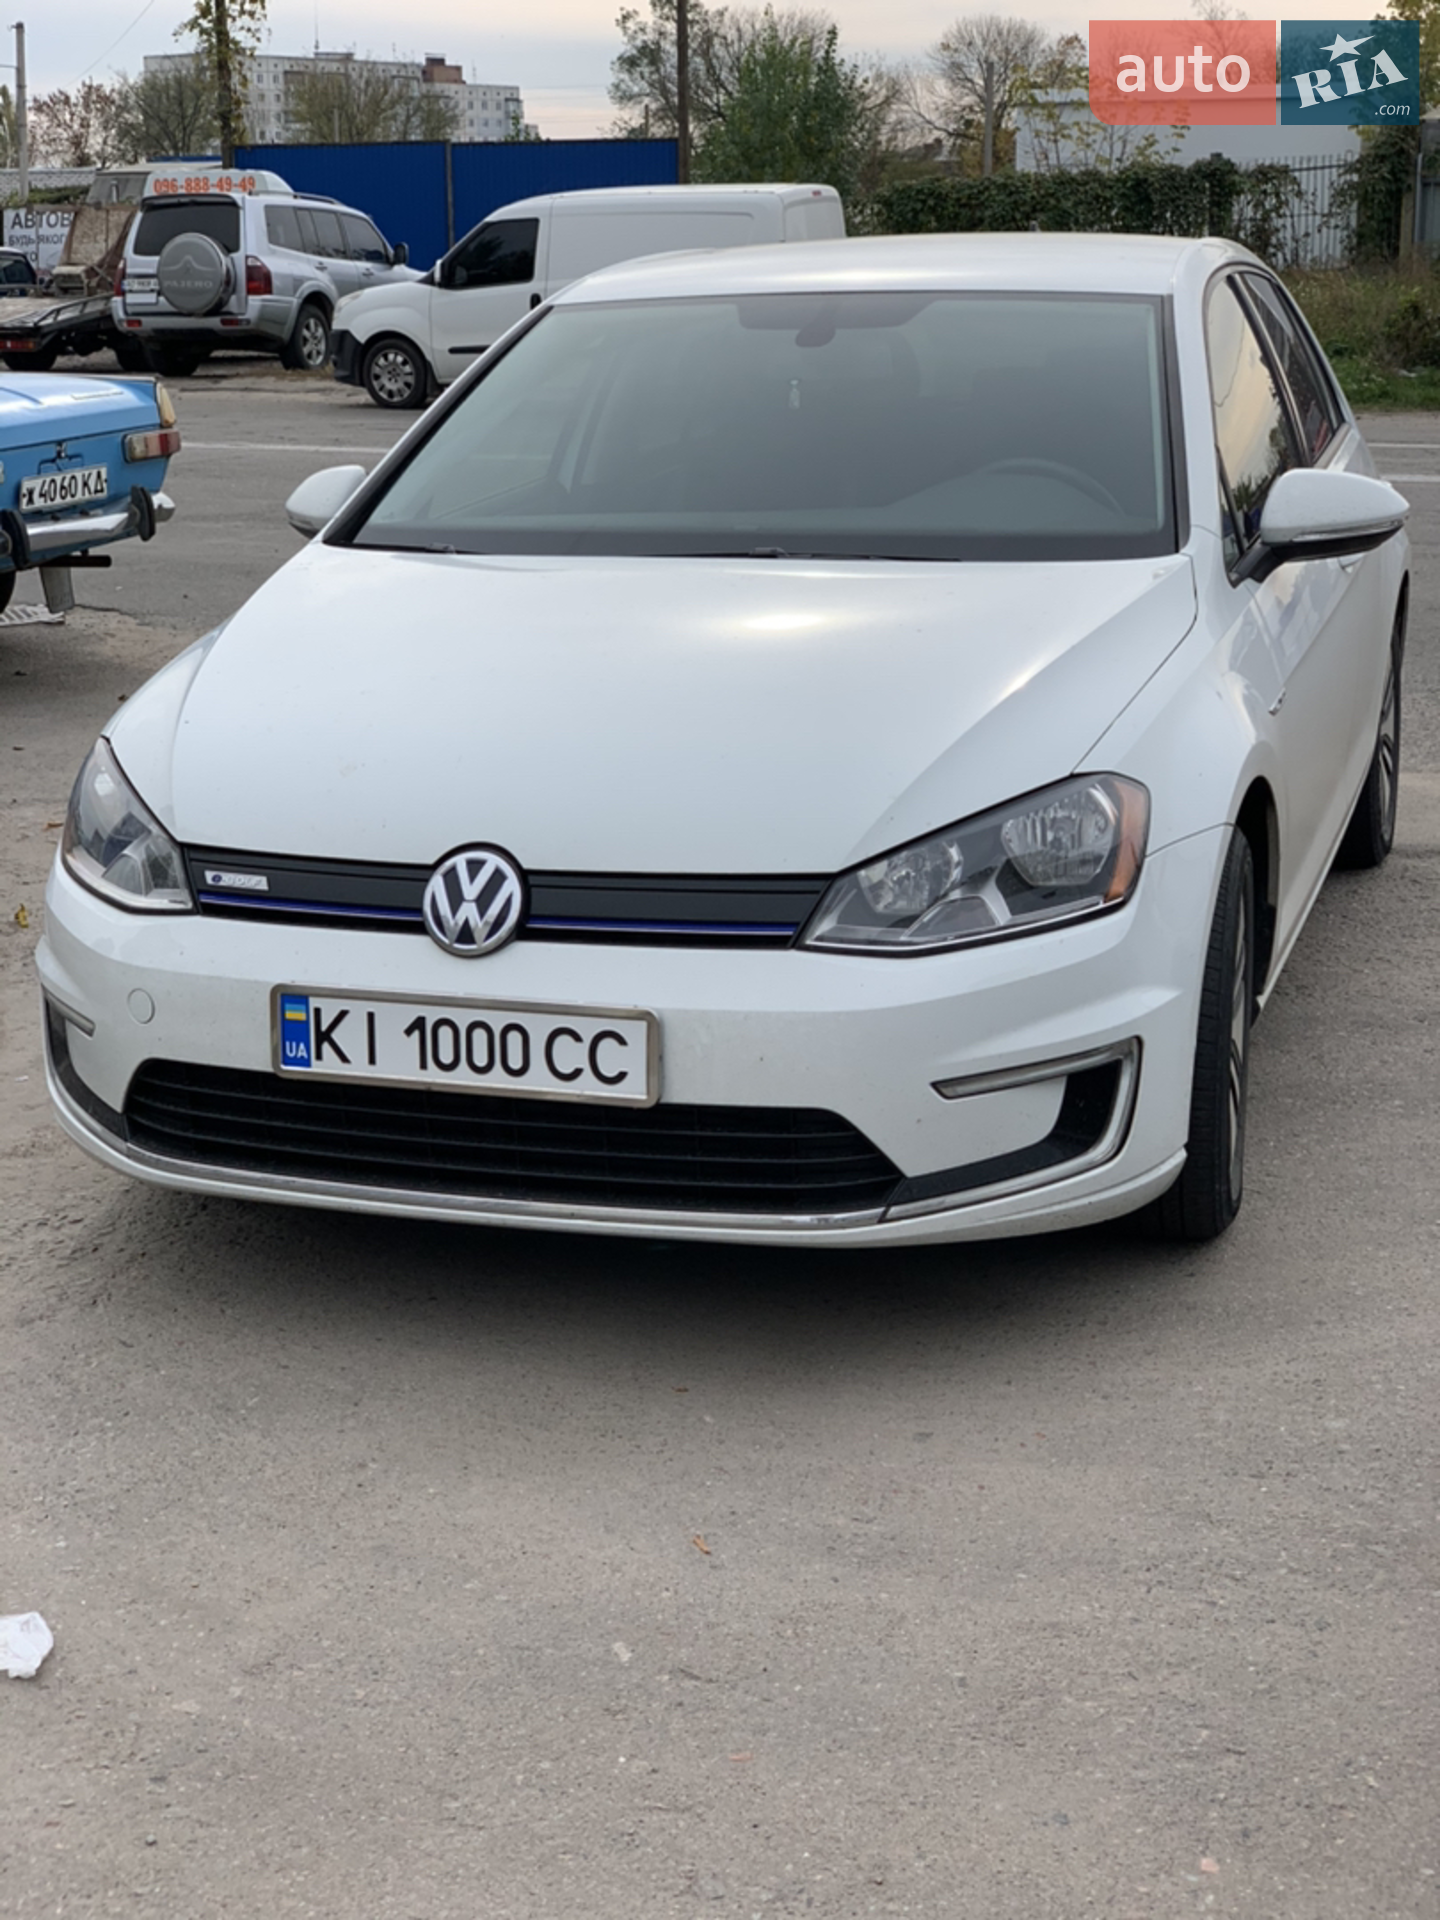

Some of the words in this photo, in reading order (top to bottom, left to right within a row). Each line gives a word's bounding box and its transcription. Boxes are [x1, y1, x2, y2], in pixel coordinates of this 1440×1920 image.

[152, 176, 256, 195] 096-888-49-49
[38, 233, 67, 245] ЯКОГ
[163, 279, 213, 289] PAJERO
[38, 474, 78, 503] 4060
[82, 470, 104, 497] КД
[424, 854, 519, 951] VW
[285, 1042, 308, 1060] UA
[403, 1015, 531, 1078] 1000
[544, 1026, 629, 1086] CC
